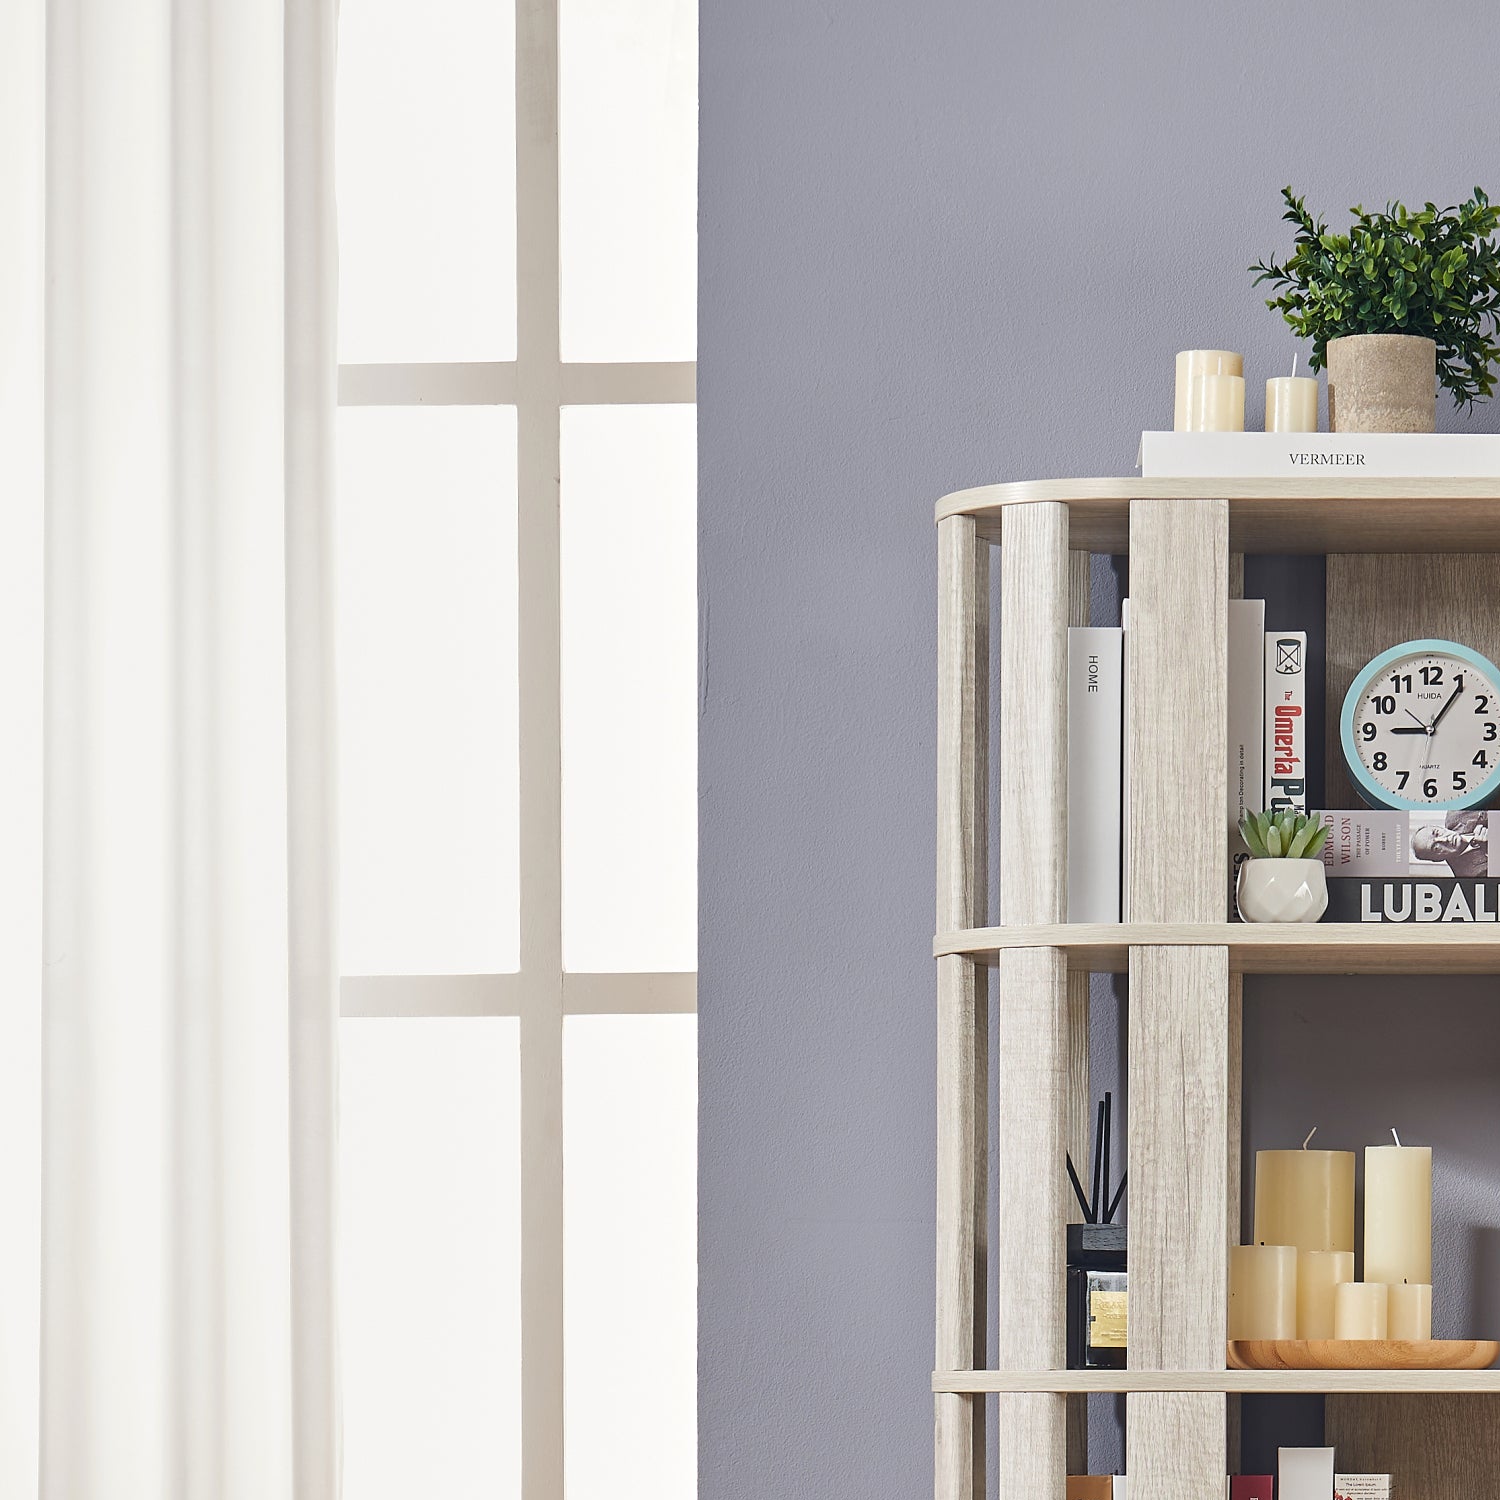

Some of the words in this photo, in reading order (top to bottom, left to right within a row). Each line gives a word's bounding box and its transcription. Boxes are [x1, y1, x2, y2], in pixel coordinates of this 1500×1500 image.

[1289, 453, 1366, 466] VERMEER
[1088, 655, 1099, 693] HOME
[1419, 667, 1443, 685] 12
[1453, 674, 1464, 693] 1
[1390, 675, 1412, 693] 11
[1371, 695, 1396, 715] 10
[1474, 695, 1489, 714] 2
[1274, 705, 1302, 775] Omerta
[1362, 722, 1377, 742] 9
[1483, 722, 1497, 742] 3
[1372, 752, 1387, 771] 8
[1472, 750, 1488, 769] 4
[1395, 771, 1410, 790] 7
[1423, 778, 1438, 798] 6
[1452, 771, 1467, 791] 5
[1341, 817, 1351, 864] WILSON
